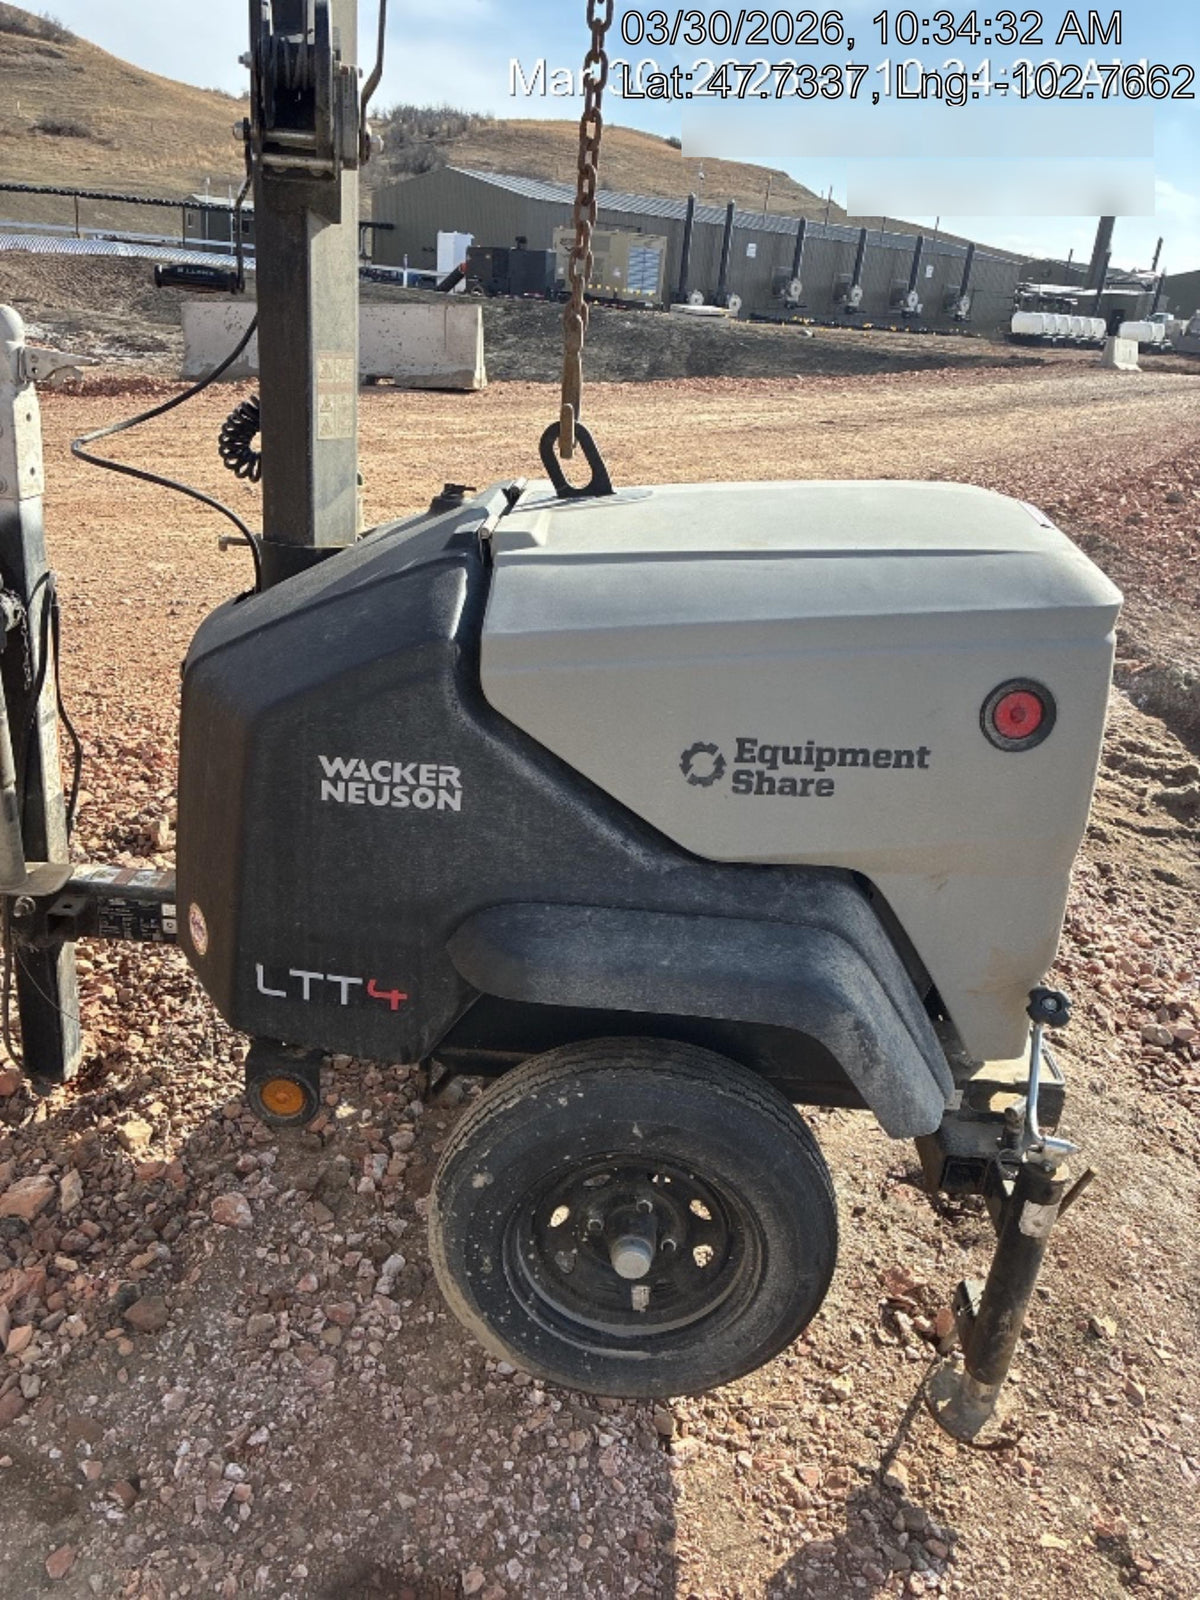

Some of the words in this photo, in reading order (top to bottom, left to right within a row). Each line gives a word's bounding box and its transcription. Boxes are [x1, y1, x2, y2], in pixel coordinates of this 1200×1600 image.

[318, 754, 463, 789] WACKER
[733, 737, 931, 772] Equipment
[321, 779, 463, 812] NEUSON
[731, 769, 835, 797] Share
[255, 962, 408, 1011] LTT4
